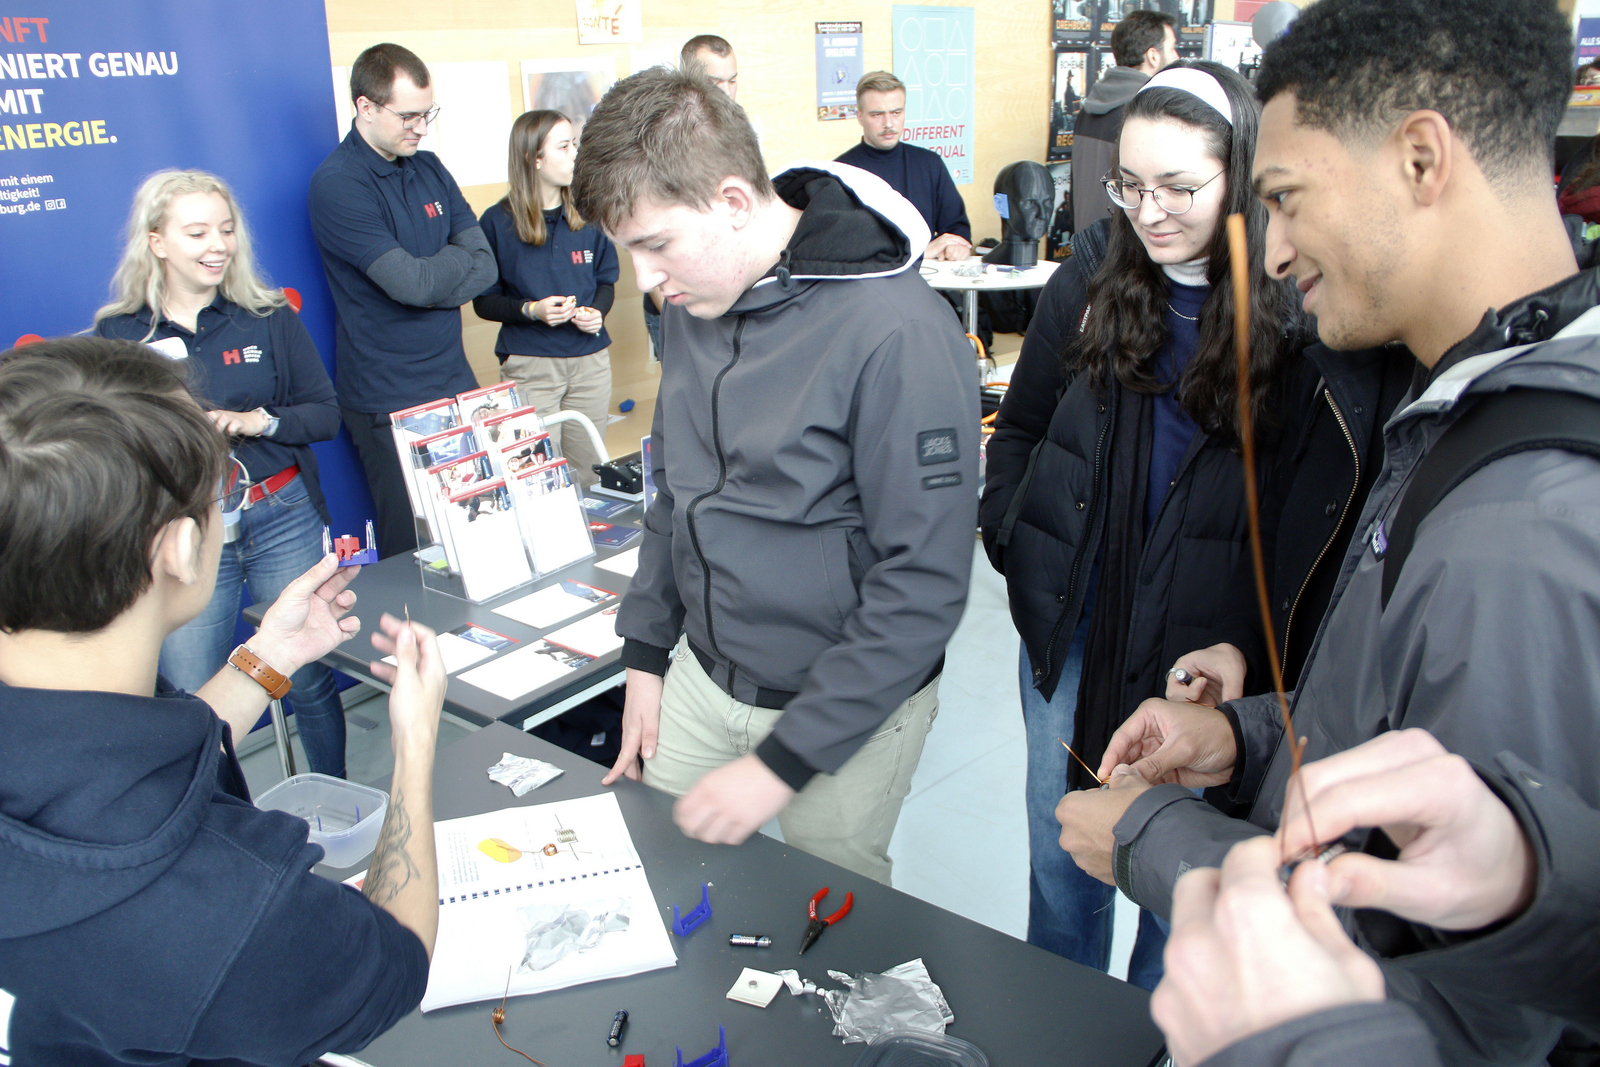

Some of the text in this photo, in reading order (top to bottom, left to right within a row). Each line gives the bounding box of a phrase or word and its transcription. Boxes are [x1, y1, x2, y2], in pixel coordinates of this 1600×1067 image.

[1056, 19, 1092, 30] DREHBUCH
[0, 51, 178, 79] NIERT GENAU
[0, 88, 44, 115] MIT
[902, 124, 965, 142] DIFFERENT
[0, 174, 54, 187] mit einem
[222, 349, 241, 365] H
